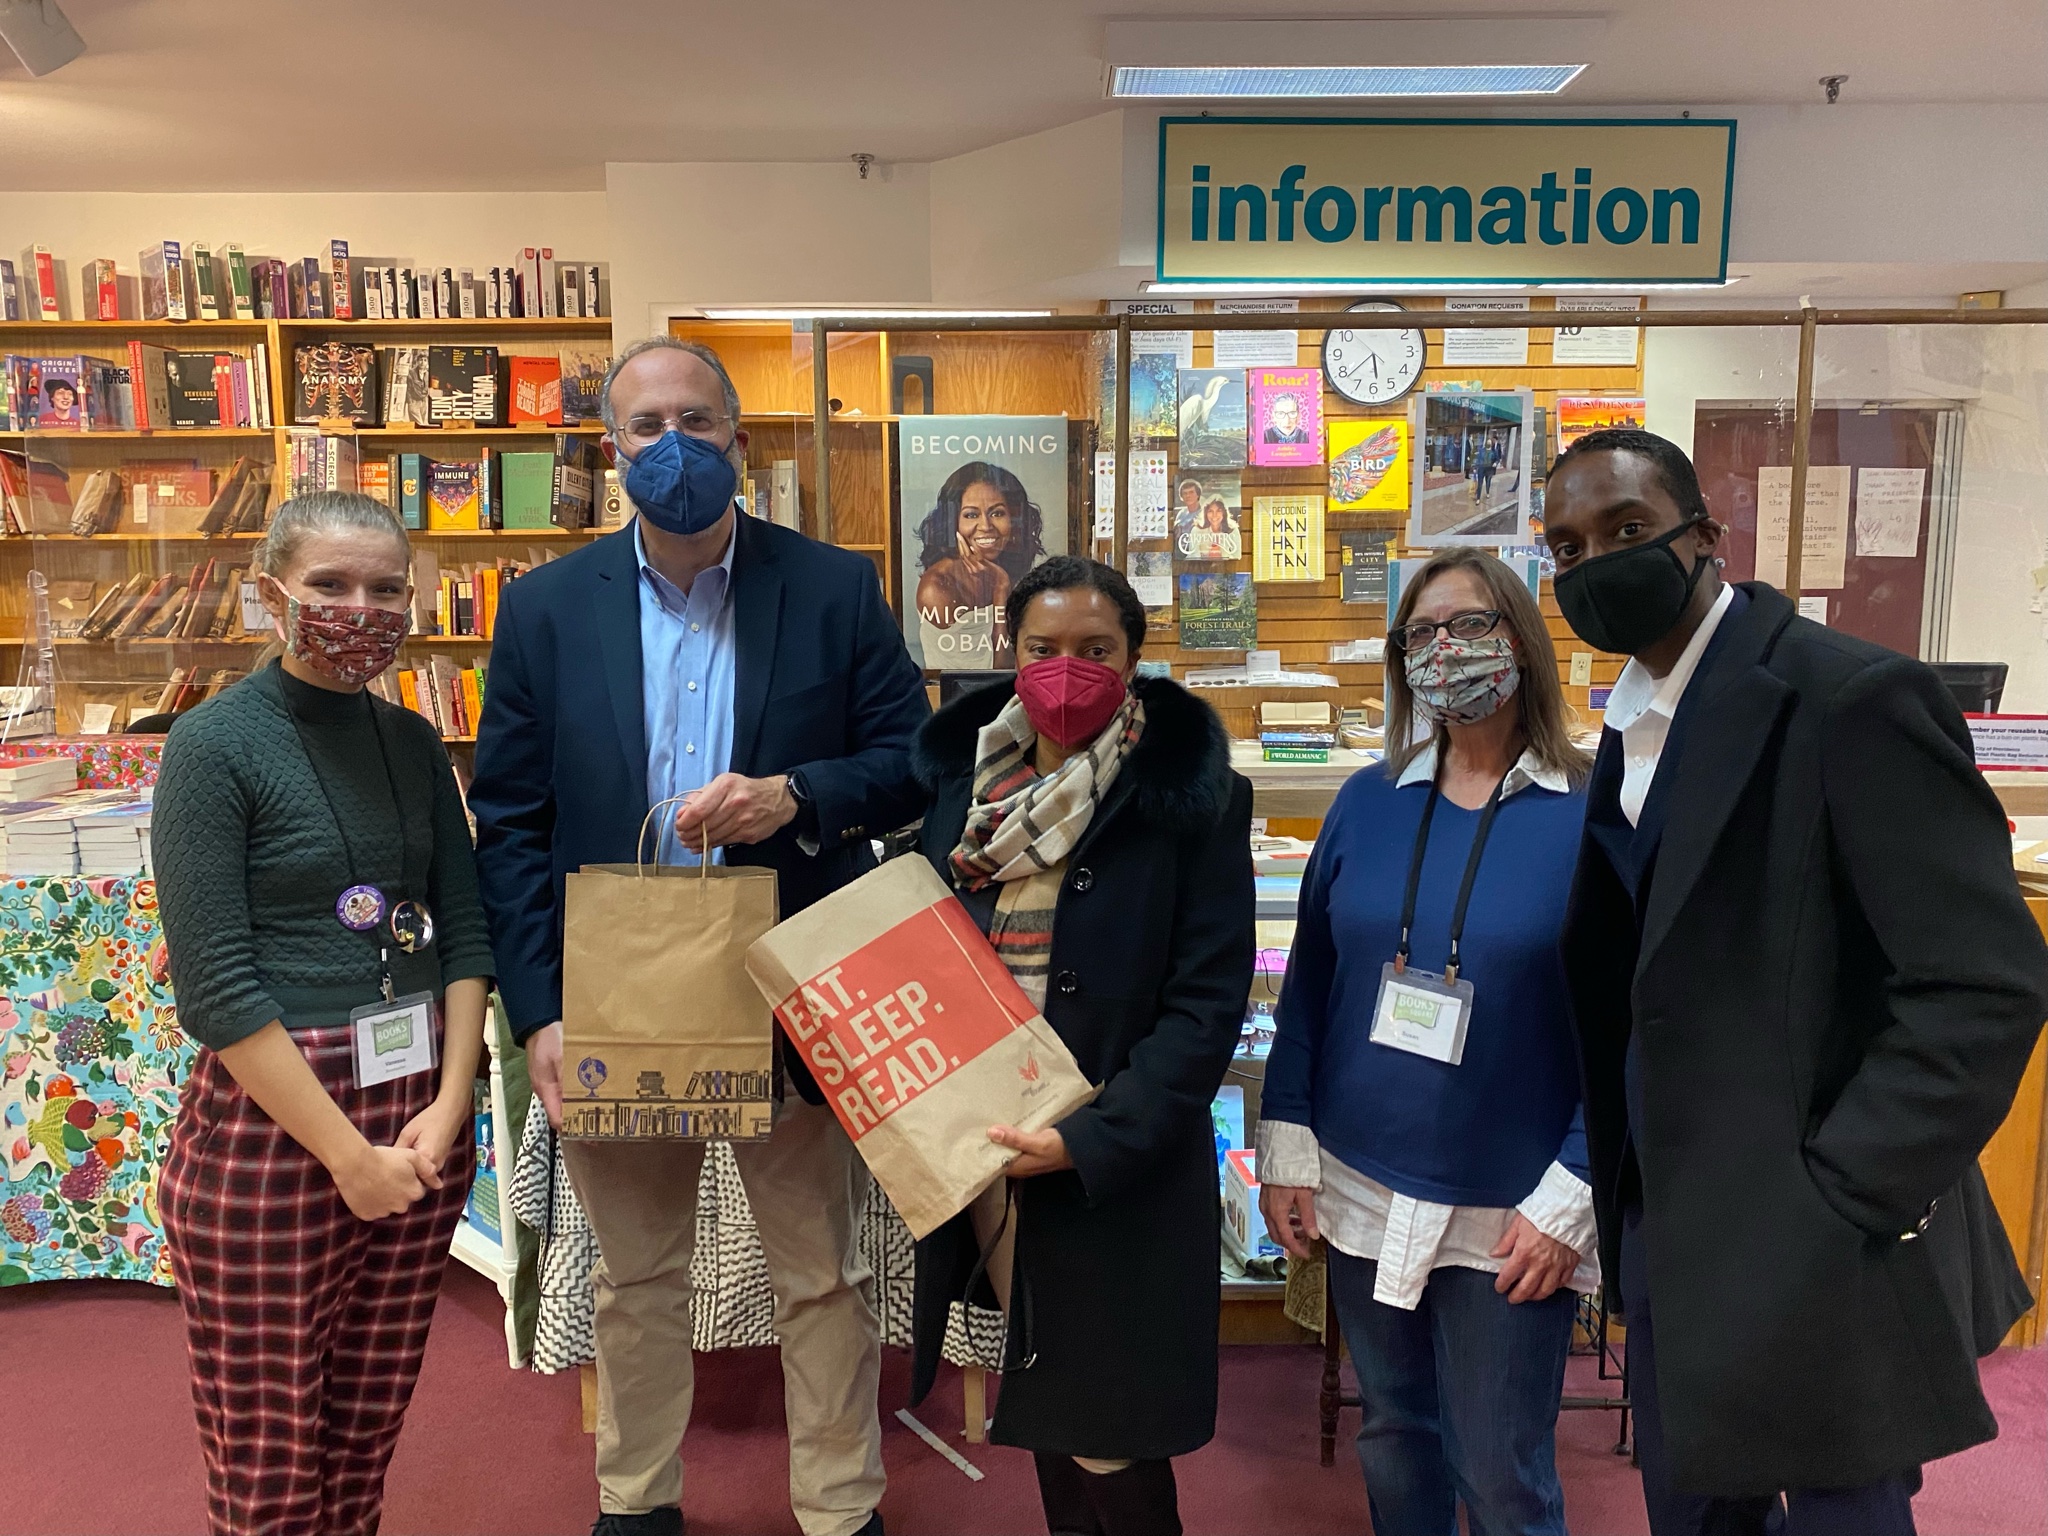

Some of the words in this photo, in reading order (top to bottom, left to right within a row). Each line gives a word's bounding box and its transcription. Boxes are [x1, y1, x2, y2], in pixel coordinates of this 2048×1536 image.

[1191, 165, 1700, 246] information
[1127, 304, 1177, 314] SPECIAL
[1339, 330, 1353, 342] 10
[1400, 329, 1409, 340] 2
[1333, 348, 1342, 361] 9
[1406, 345, 1414, 358] 3
[102, 368, 130, 377] BLACK
[1338, 366, 1348, 378] 8
[1399, 363, 1408, 375] 4
[103, 376, 131, 385] FUTUR
[302, 375, 367, 385] ANATOMY
[1263, 372, 1309, 387] Roar!
[1353, 379, 1362, 391] 7
[1386, 378, 1395, 390] 5
[580, 387, 598, 396] CITI
[1369, 383, 1378, 394] 6
[431, 396, 452, 420] FUN
[452, 389, 473, 420] CITY
[472, 375, 494, 420] CINEMA
[911, 435, 1058, 455] BECOMING
[1350, 459, 1386, 472] BIRD
[434, 471, 469, 480] IMMUNE
[1272, 505, 1307, 516] DECODING
[1272, 518, 1307, 532] MAN
[1272, 535, 1307, 550] HAT
[1273, 553, 1307, 568] TAN
[244, 597, 262, 605] Plea
[920, 605, 1005, 624] MICHE
[1185, 621, 1218, 629] FOREST
[1219, 621, 1252, 629] TRAILS
[938, 633, 1010, 652] OBAM
[780, 966, 868, 1042] EAT.
[1398, 995, 1435, 1011] BOOKS
[376, 1021, 407, 1043] BOOKS
[811, 980, 944, 1086] SLEEP.
[837, 1037, 961, 1135] READ.
